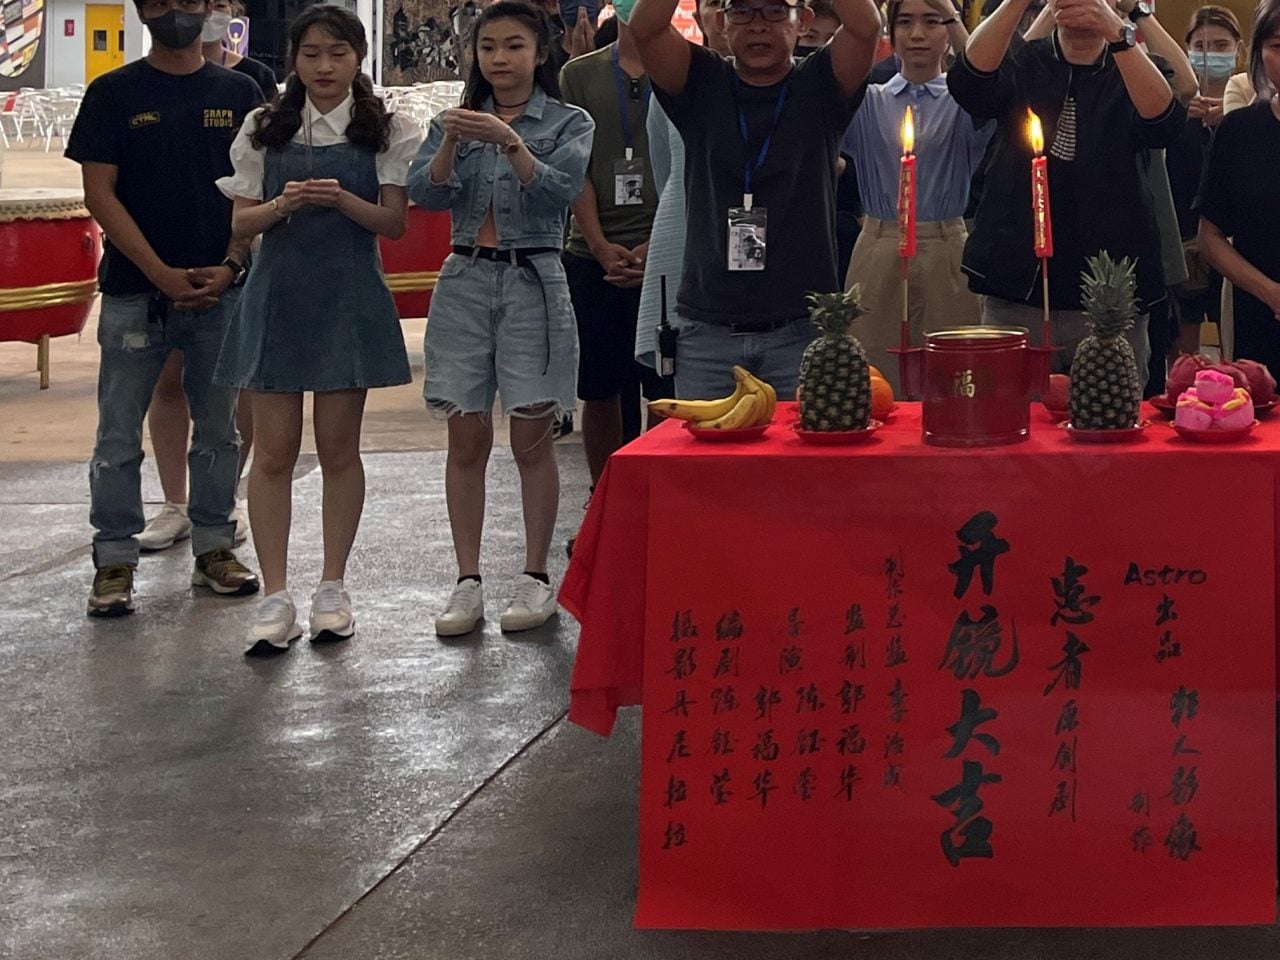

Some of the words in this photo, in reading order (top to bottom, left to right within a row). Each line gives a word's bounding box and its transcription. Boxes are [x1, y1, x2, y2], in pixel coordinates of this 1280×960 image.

[203, 109, 233, 119] GRAPH
[1123, 561, 1208, 587] Astro
[1154, 593, 1182, 664] 出品
[931, 510, 1020, 869] 开镜大吉
